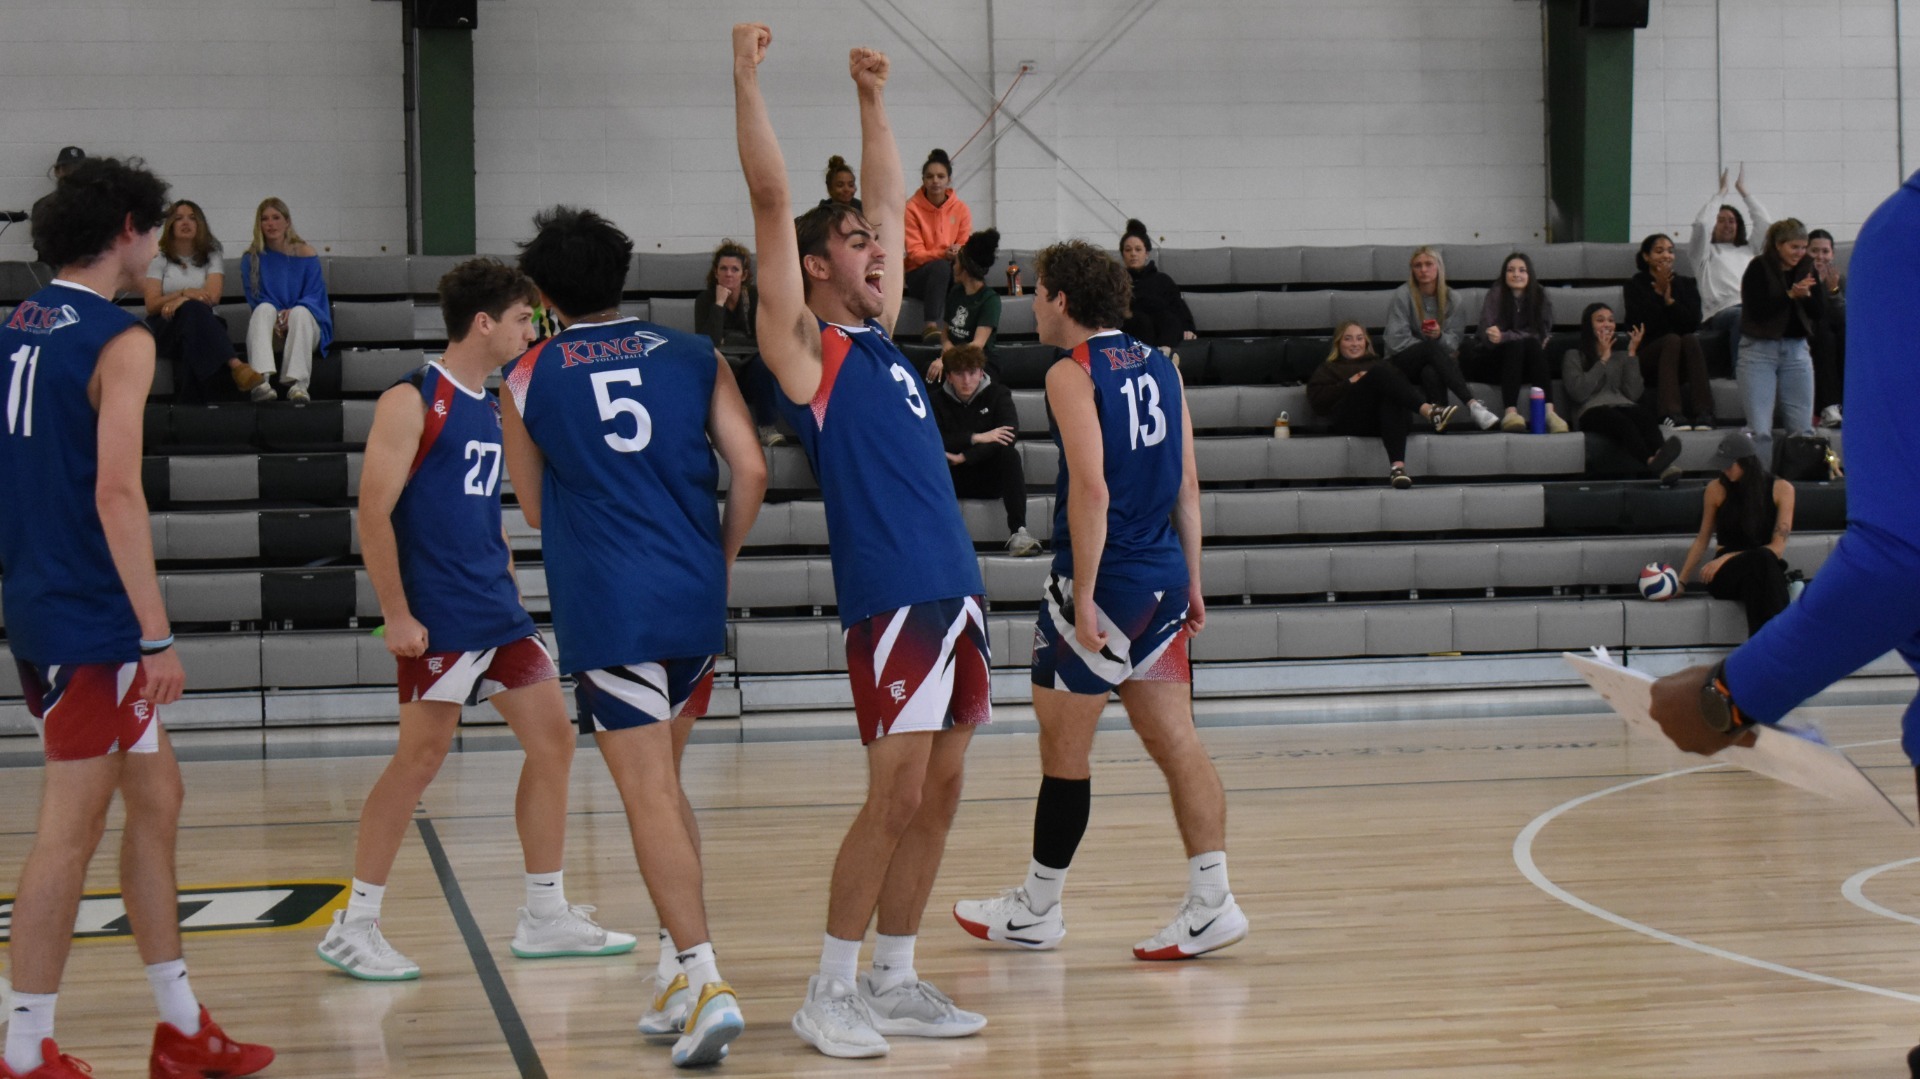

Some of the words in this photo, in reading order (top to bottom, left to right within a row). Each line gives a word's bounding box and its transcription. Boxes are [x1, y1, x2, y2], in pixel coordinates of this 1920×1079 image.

[557, 336, 644, 368] KING
[594, 353, 643, 363] VOLLEYBALL
[7, 344, 40, 437] 11
[590, 368, 652, 453] 5
[890, 363, 926, 418] 3
[1120, 373, 1167, 450] 13
[464, 440, 501, 496] 27
